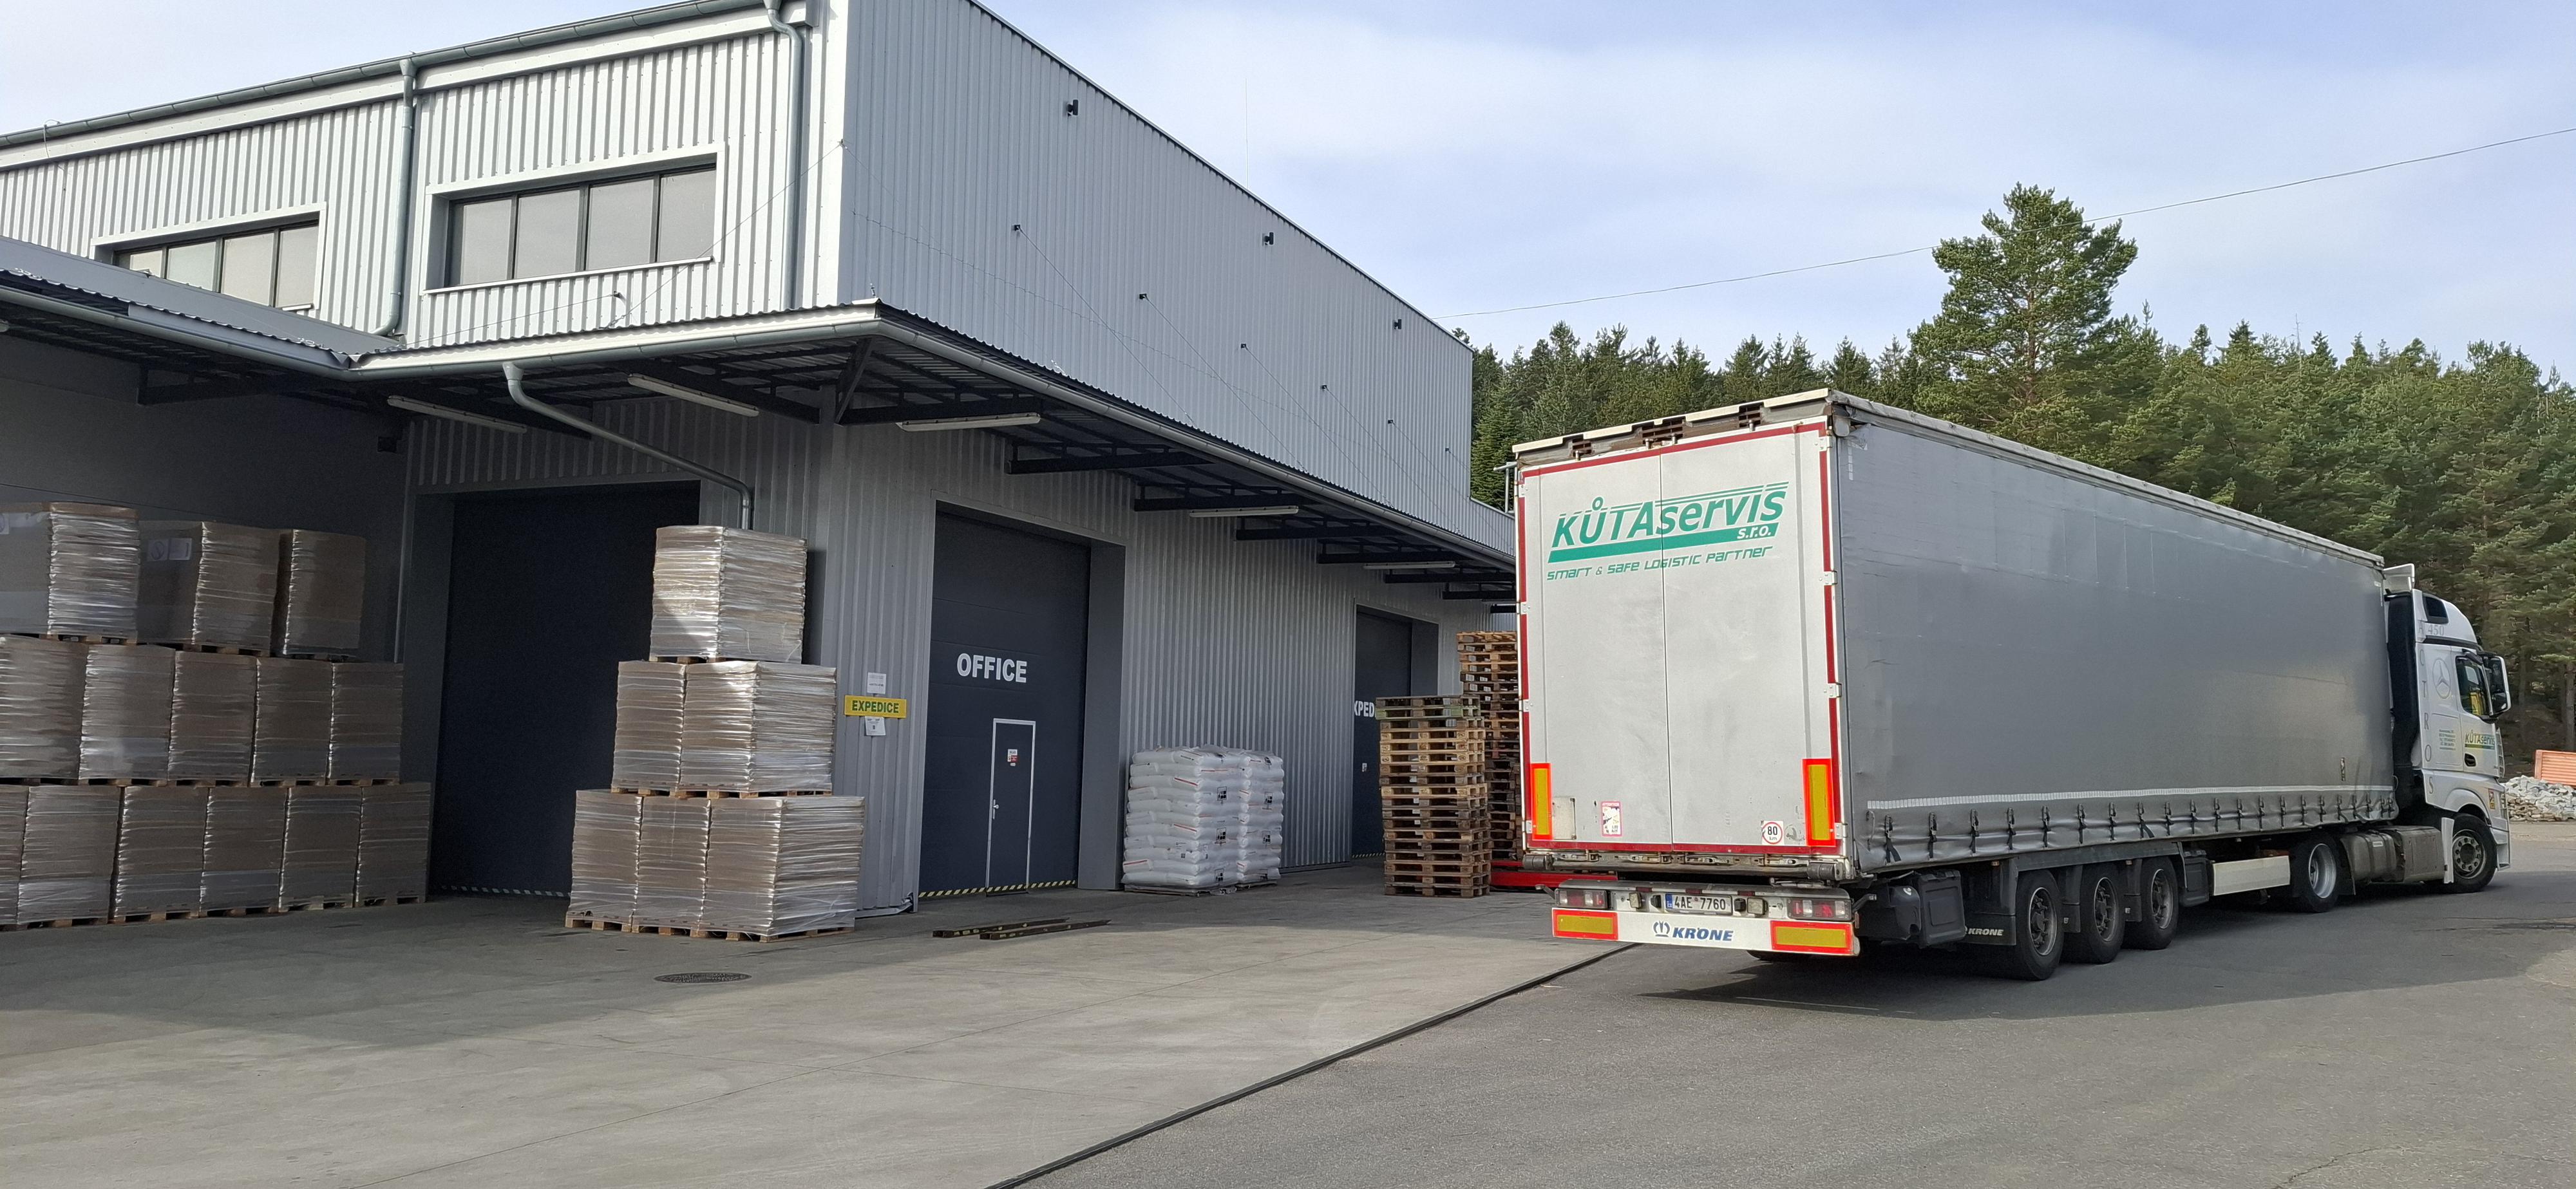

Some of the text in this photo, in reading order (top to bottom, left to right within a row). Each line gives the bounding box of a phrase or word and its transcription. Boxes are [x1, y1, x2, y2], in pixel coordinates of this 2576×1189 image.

[1737, 524, 1772, 539] s.r.o.
[1596, 566, 1603, 576] &
[2428, 624, 2445, 636] 450
[957, 653, 1027, 683] OFFICE
[851, 700, 899, 713] EXPEDICE
[1767, 826, 1777, 835] 80
[1674, 895, 1726, 910] 4AE 7760
[1672, 927, 1734, 941] KRONE
